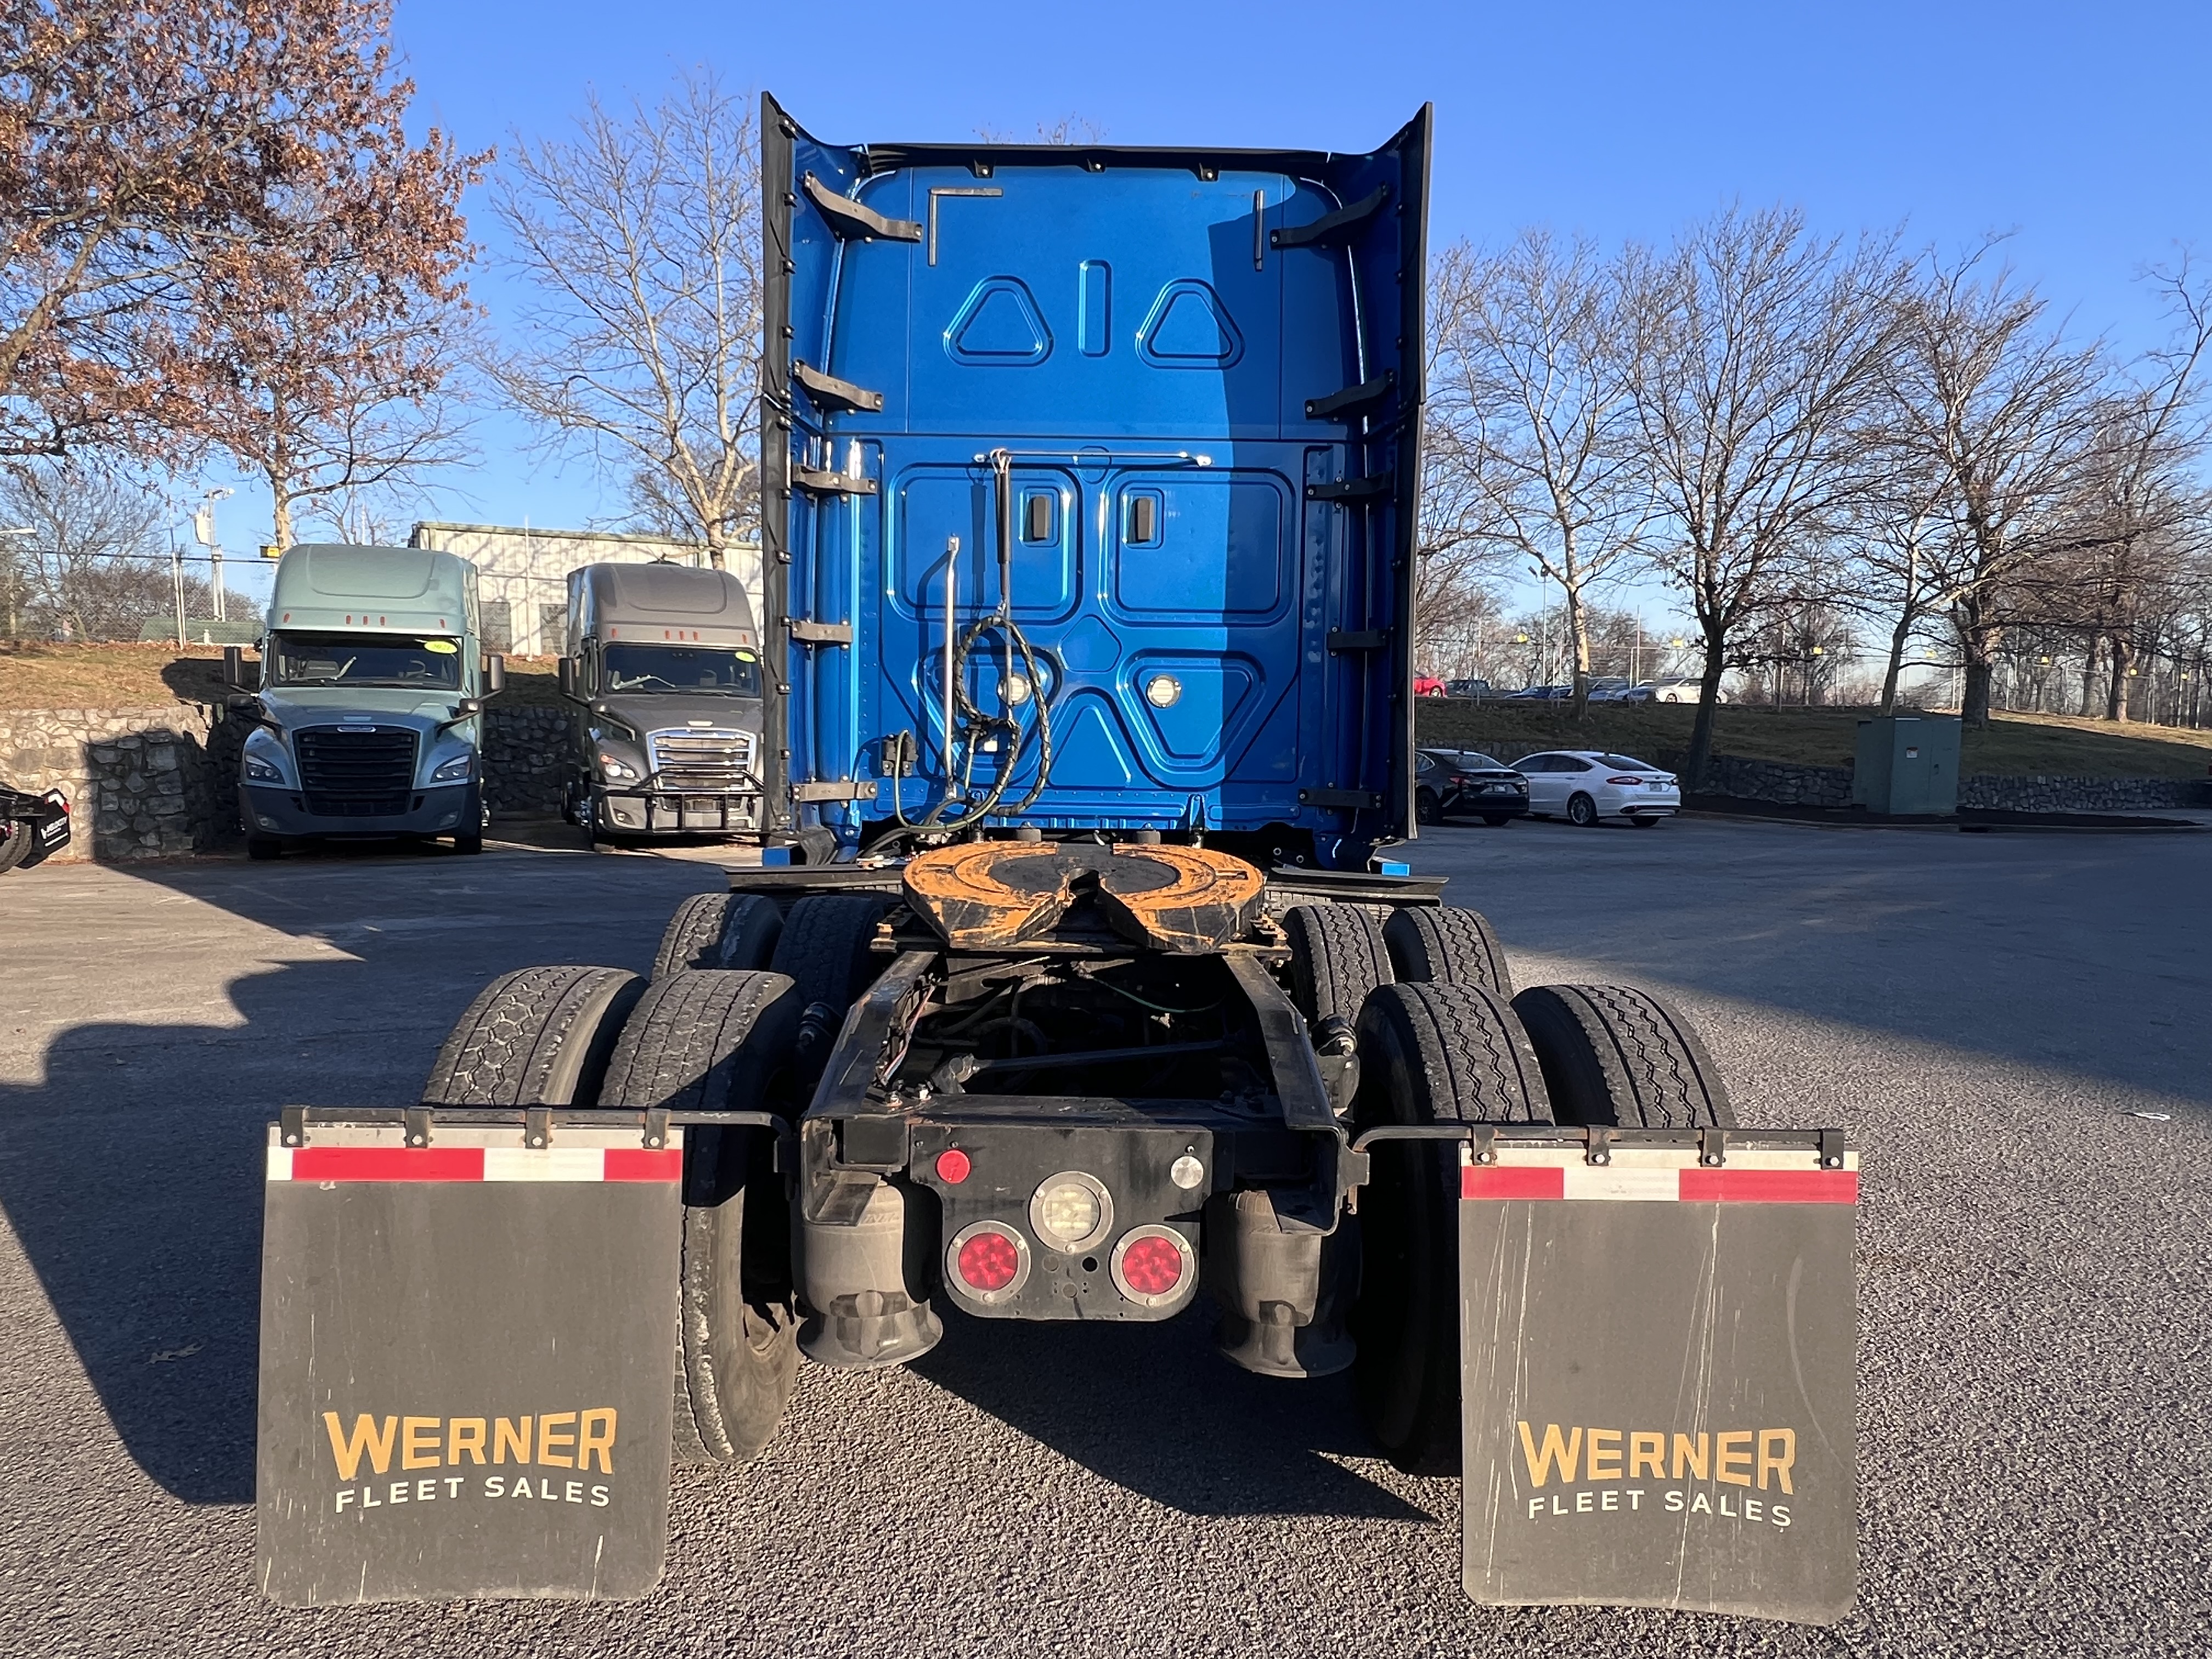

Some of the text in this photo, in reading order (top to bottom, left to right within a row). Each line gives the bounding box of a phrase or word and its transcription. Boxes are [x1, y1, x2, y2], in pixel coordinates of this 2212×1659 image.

[321, 1407, 617, 1481] WERNER
[1517, 1421, 1796, 1495] WERNER
[335, 1476, 610, 1513] FLEET SALES
[1527, 1489, 1792, 1527] FLEET SALES
